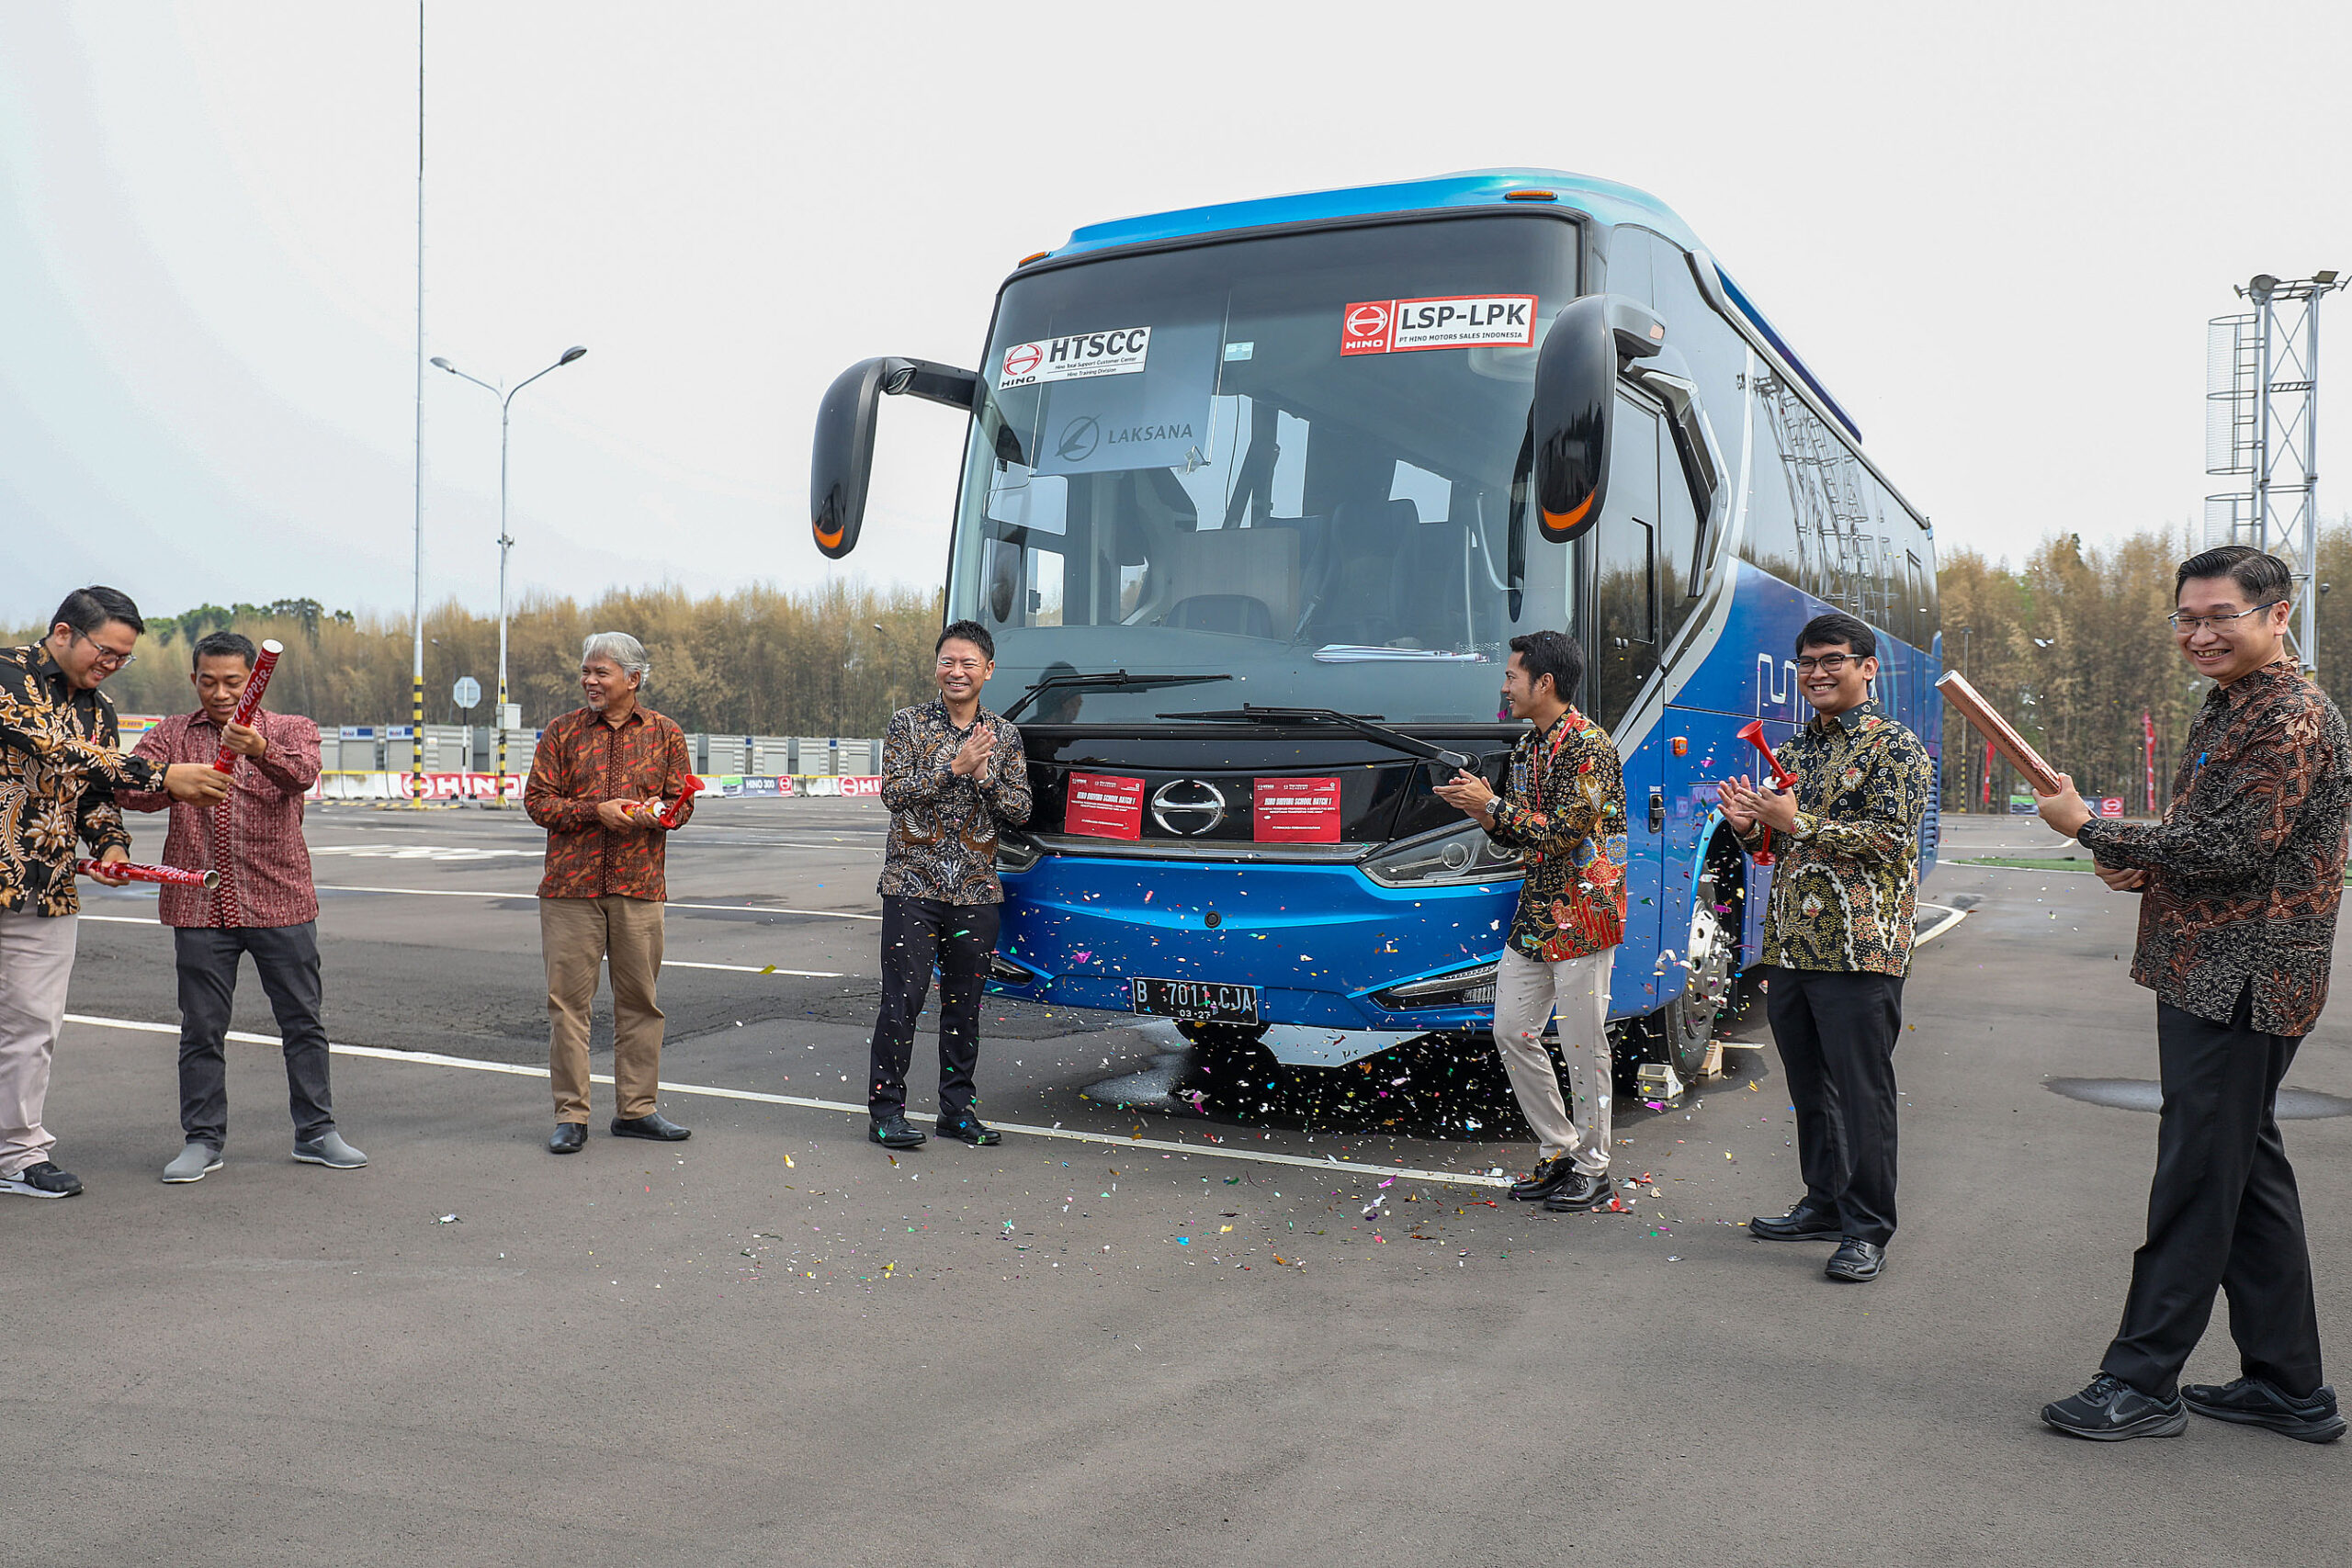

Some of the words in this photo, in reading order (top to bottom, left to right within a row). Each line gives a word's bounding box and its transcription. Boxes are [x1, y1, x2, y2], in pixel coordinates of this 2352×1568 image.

[1400, 303, 1528, 330] LSP-LPK
[1049, 329, 1147, 363] HTSCC
[1345, 339, 1384, 349] HINO
[1001, 376, 1035, 388] HINO
[1108, 423, 1193, 445] LAKSANA
[745, 779, 763, 789] HINO
[763, 779, 775, 789] 300
[1295, 797, 1312, 806] SCHOOL
[1136, 980, 1148, 1003] B
[1166, 982, 1210, 1008] 7011
[1219, 987, 1252, 1011] CJA
